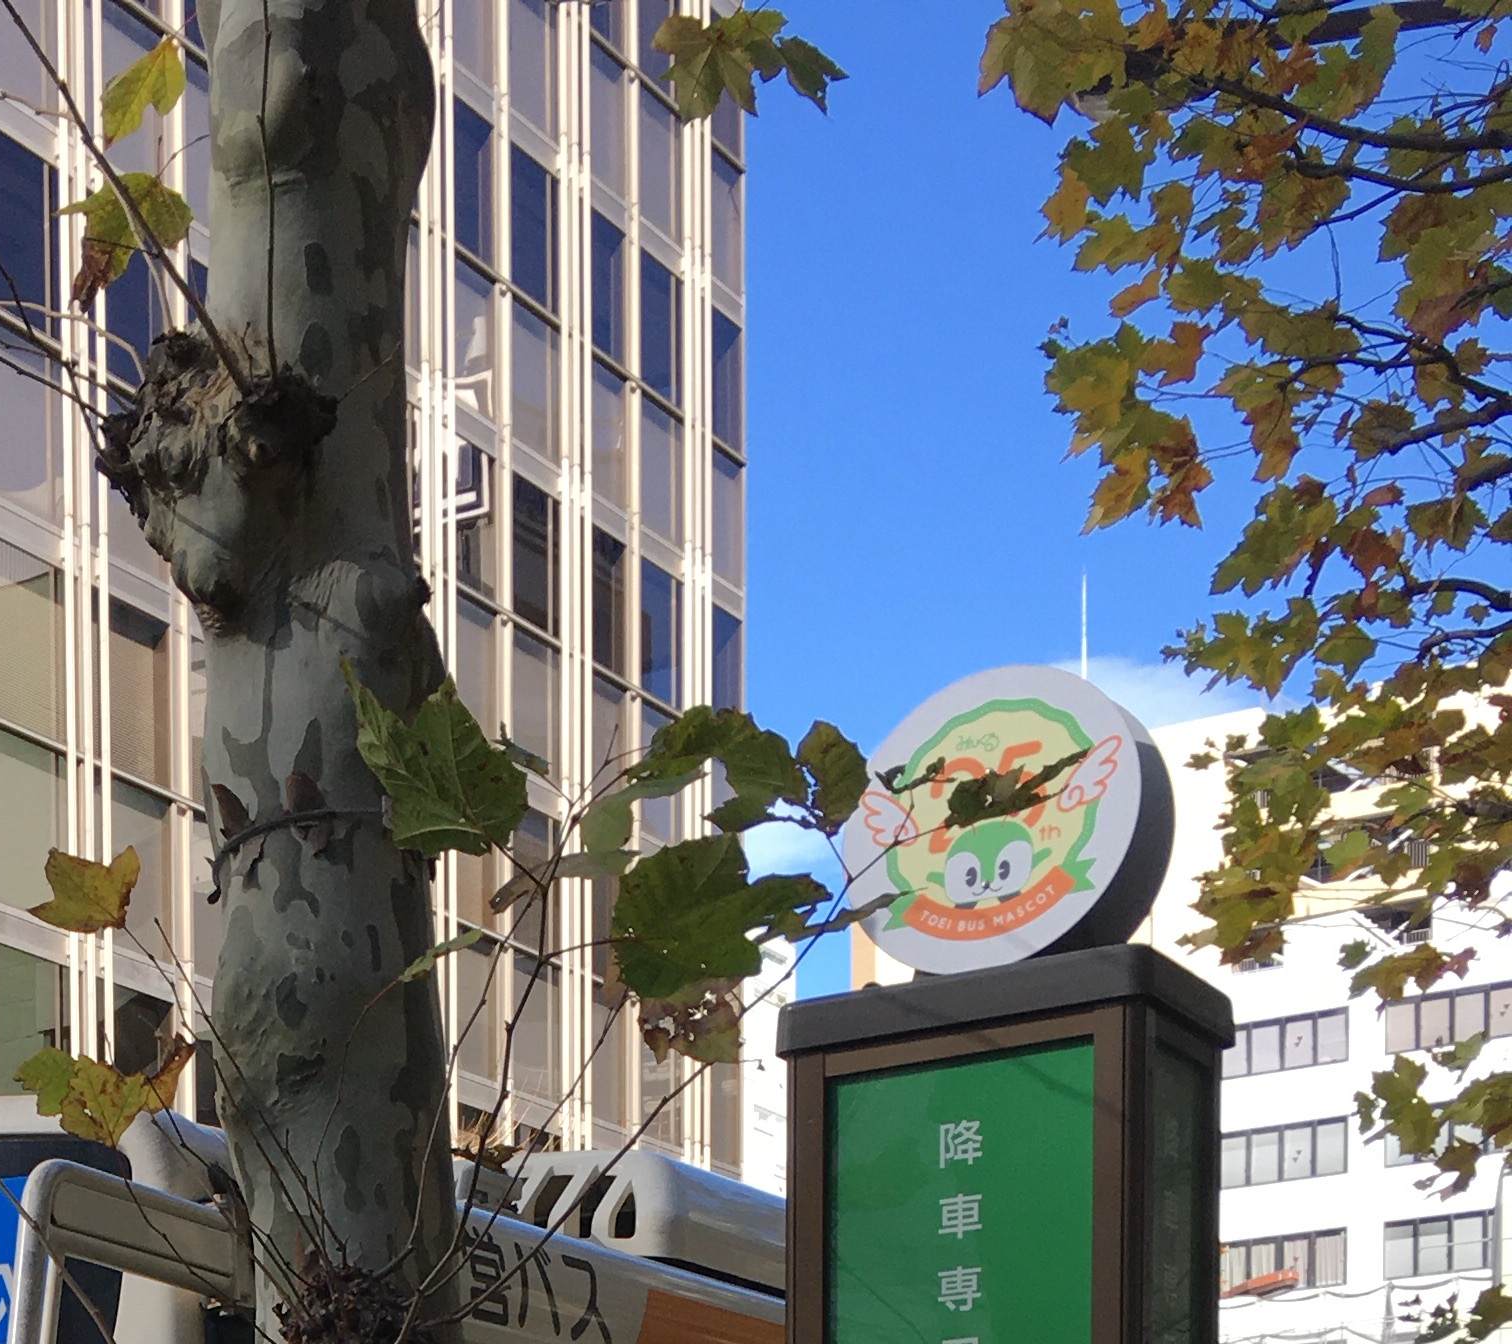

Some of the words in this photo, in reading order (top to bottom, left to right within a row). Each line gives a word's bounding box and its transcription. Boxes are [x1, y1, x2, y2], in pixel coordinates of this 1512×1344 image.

[919, 908, 953, 931] TOEI
[957, 912, 987, 932] BUS
[992, 884, 1057, 928] MASCOT
